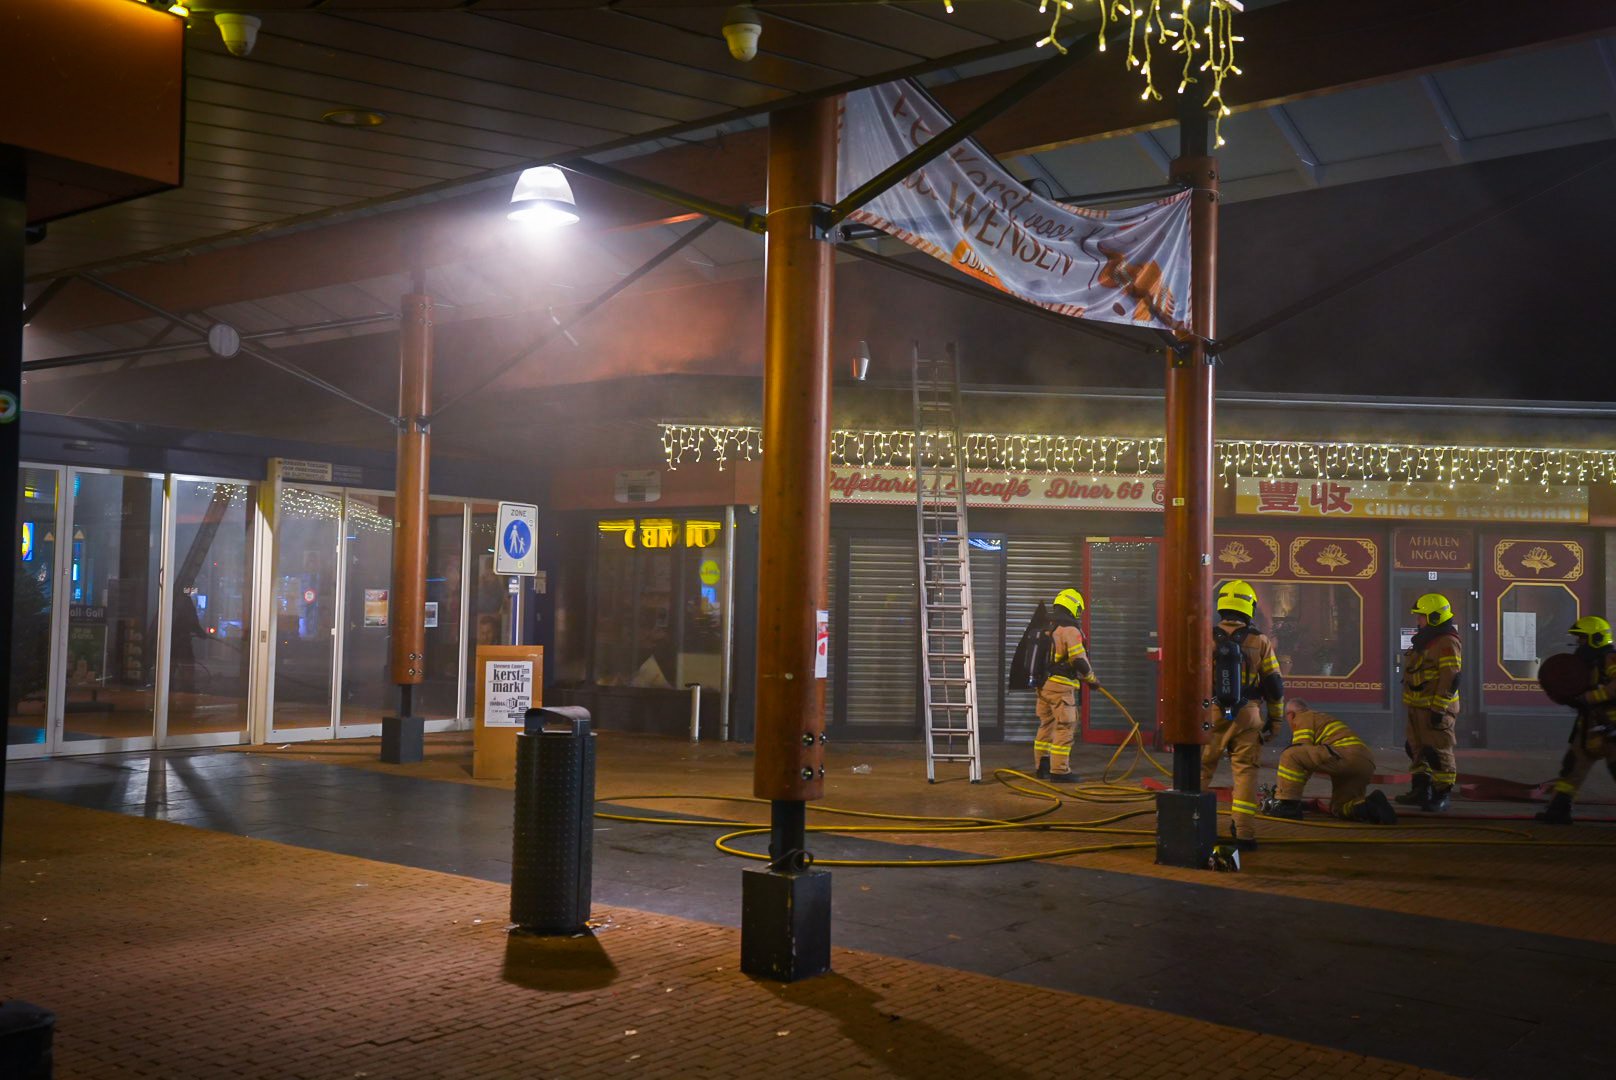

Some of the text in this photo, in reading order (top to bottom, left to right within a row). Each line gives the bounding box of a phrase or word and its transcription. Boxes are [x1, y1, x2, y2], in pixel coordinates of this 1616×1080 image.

[948, 182, 1074, 276] WENSEN
[1044, 479, 1114, 499] Diner
[1116, 481, 1145, 499] 66
[1155, 490, 1165, 503] 6
[1258, 481, 1353, 513] 豐收
[510, 508, 527, 517] ZONE
[1364, 502, 1445, 517] CHINEES
[1409, 536, 1460, 547] AFHALEN
[1411, 550, 1457, 560] INGANG
[492, 681, 525, 693] markt
